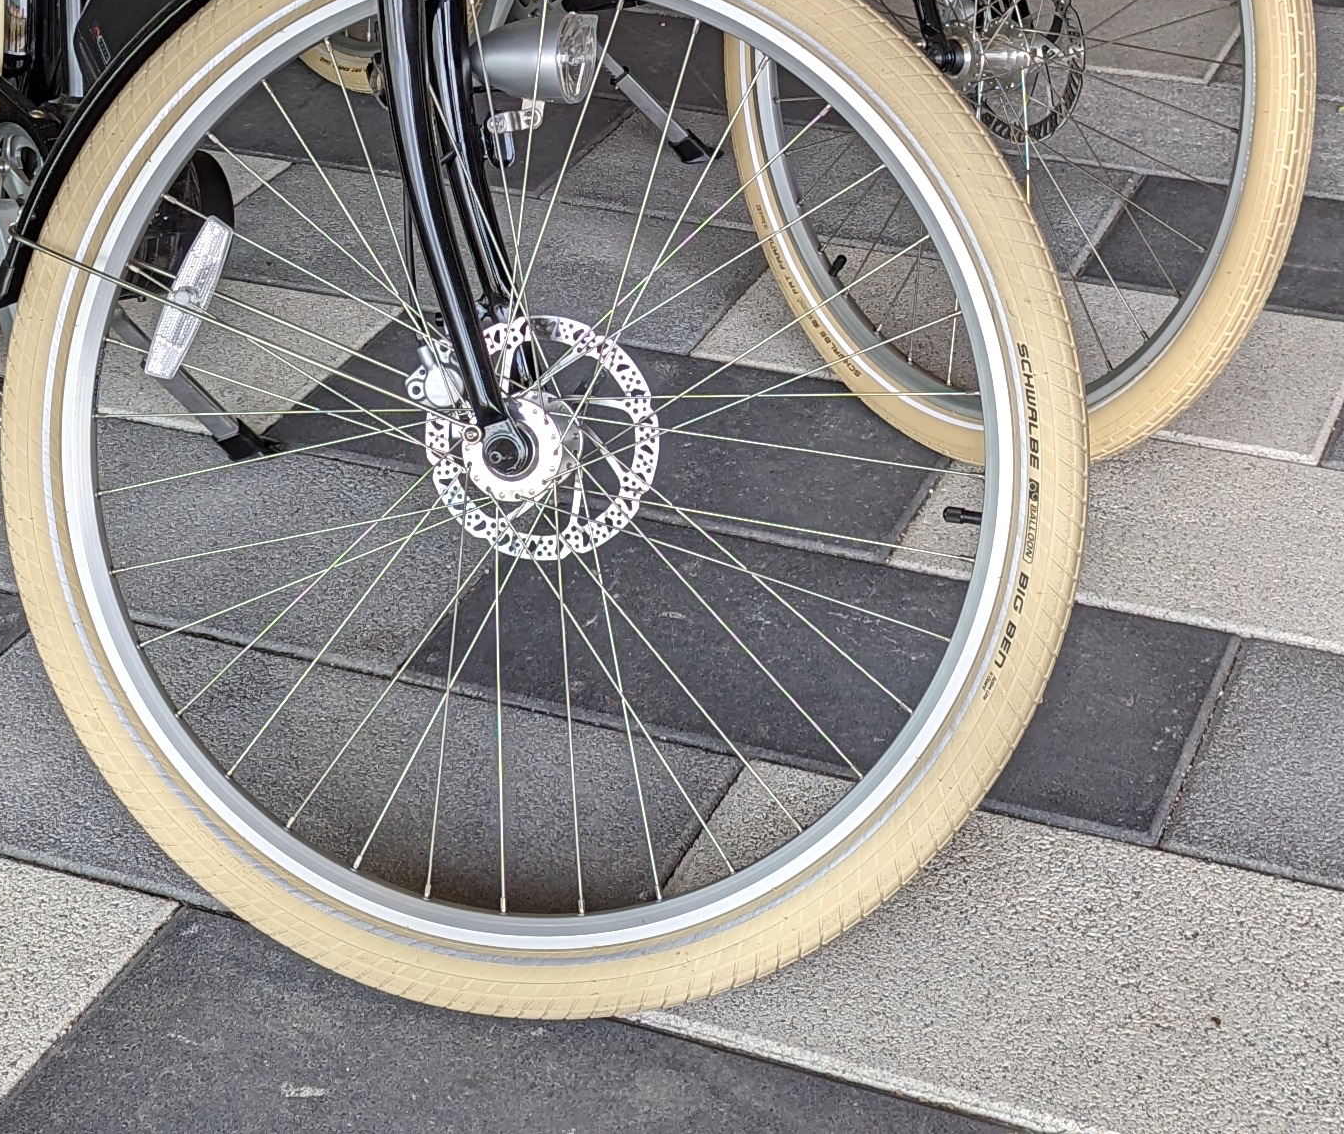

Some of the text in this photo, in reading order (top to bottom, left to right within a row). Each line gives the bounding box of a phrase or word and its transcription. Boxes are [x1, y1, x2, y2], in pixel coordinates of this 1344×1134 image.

[784, 275, 799, 295] FAT
[820, 331, 862, 378] SCHWALBE
[994, 342, 1040, 668] SCHWALBE BALLOON BIG BEN
